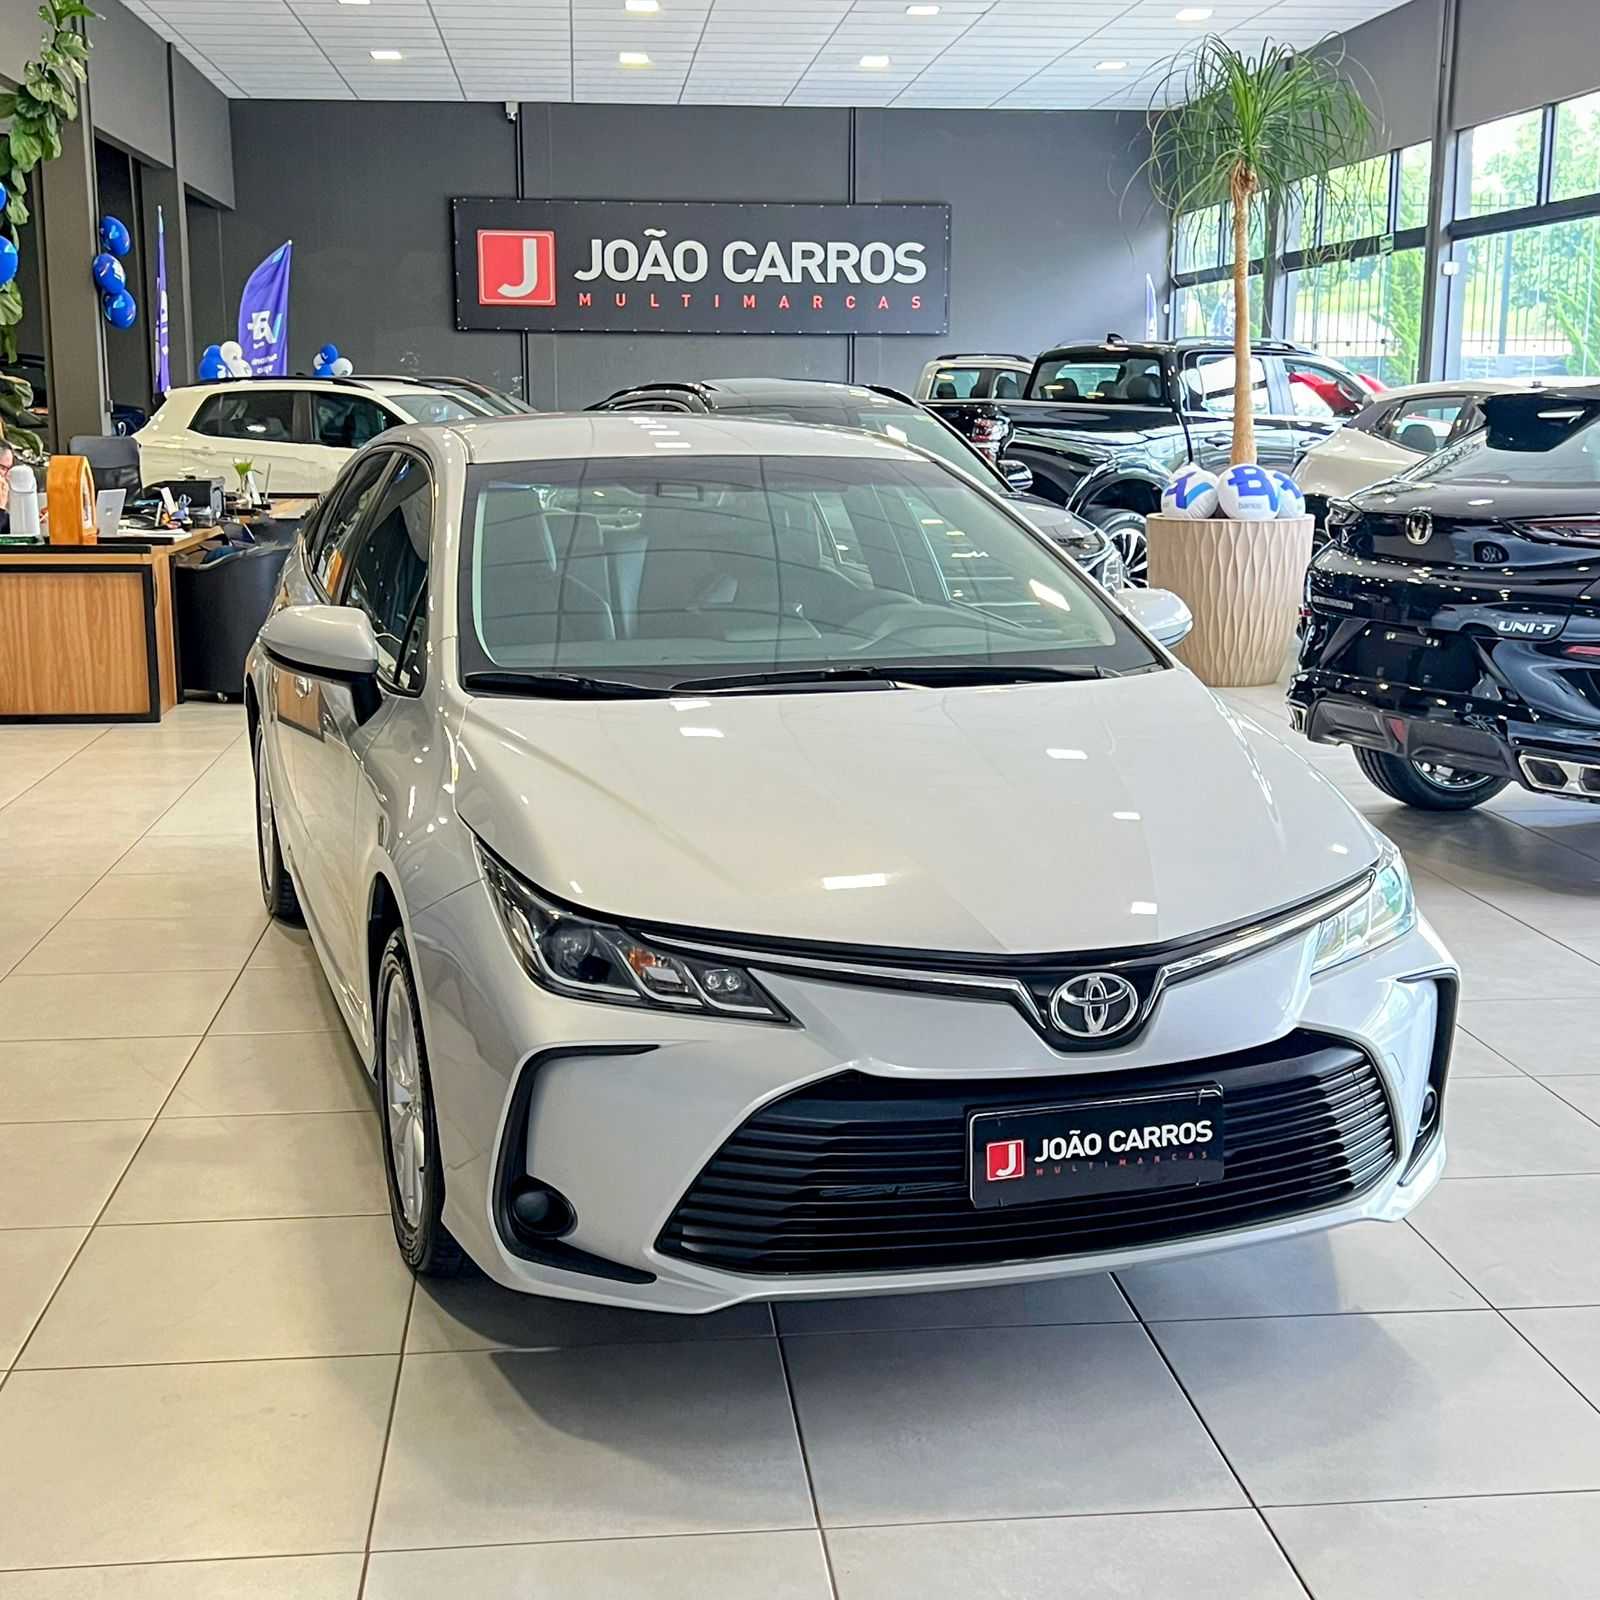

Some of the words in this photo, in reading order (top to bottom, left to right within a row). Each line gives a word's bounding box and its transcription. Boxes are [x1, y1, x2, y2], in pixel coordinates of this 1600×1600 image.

[497, 238, 537, 297] J
[574, 228, 708, 282] JOÃO
[722, 241, 927, 284] CARROS
[579, 293, 922, 309] MULTIMARCAS
[1497, 621, 1556, 635] UNI-T
[995, 1144, 1016, 1176] J
[1034, 1129, 1102, 1163] JOÃO
[1108, 1120, 1213, 1152] CARROS
[1036, 1152, 1208, 1176] MULTIMARCAS
